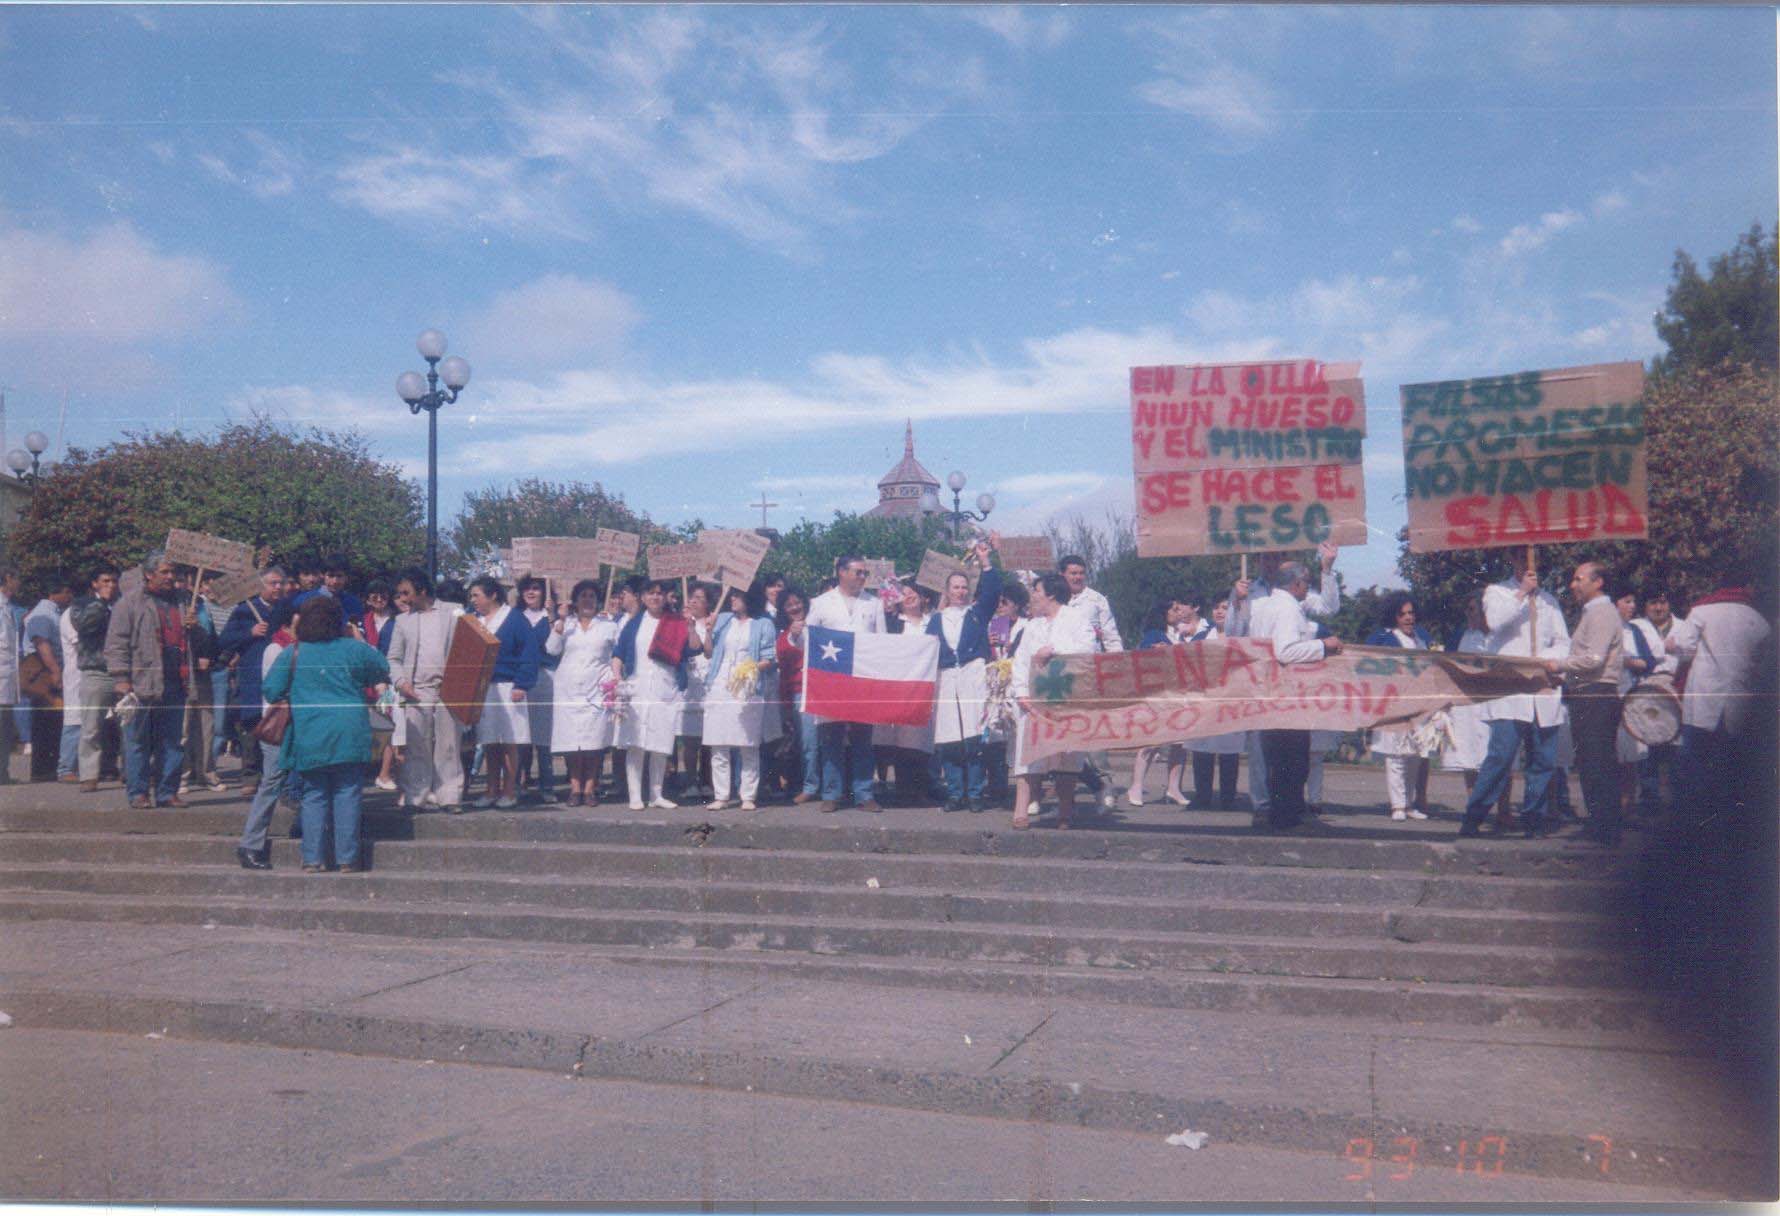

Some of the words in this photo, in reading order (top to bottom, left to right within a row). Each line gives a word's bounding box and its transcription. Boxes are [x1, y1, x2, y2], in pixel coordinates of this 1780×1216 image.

[1133, 366, 1175, 396] EN
[1190, 365, 1226, 397] LA
[1240, 359, 1330, 397] OLLA
[1228, 396, 1355, 429] HUESO
[1133, 429, 1156, 459] Y
[1164, 427, 1207, 459] EL
[1142, 471, 1192, 515] SE
[1202, 467, 1302, 504] HACE
[1315, 464, 1356, 500] EL
[1407, 461, 1458, 499] NO
[1463, 451, 1634, 495] HACEN
[1209, 503, 1332, 547] LESO
[1445, 482, 1646, 546] SALUD
